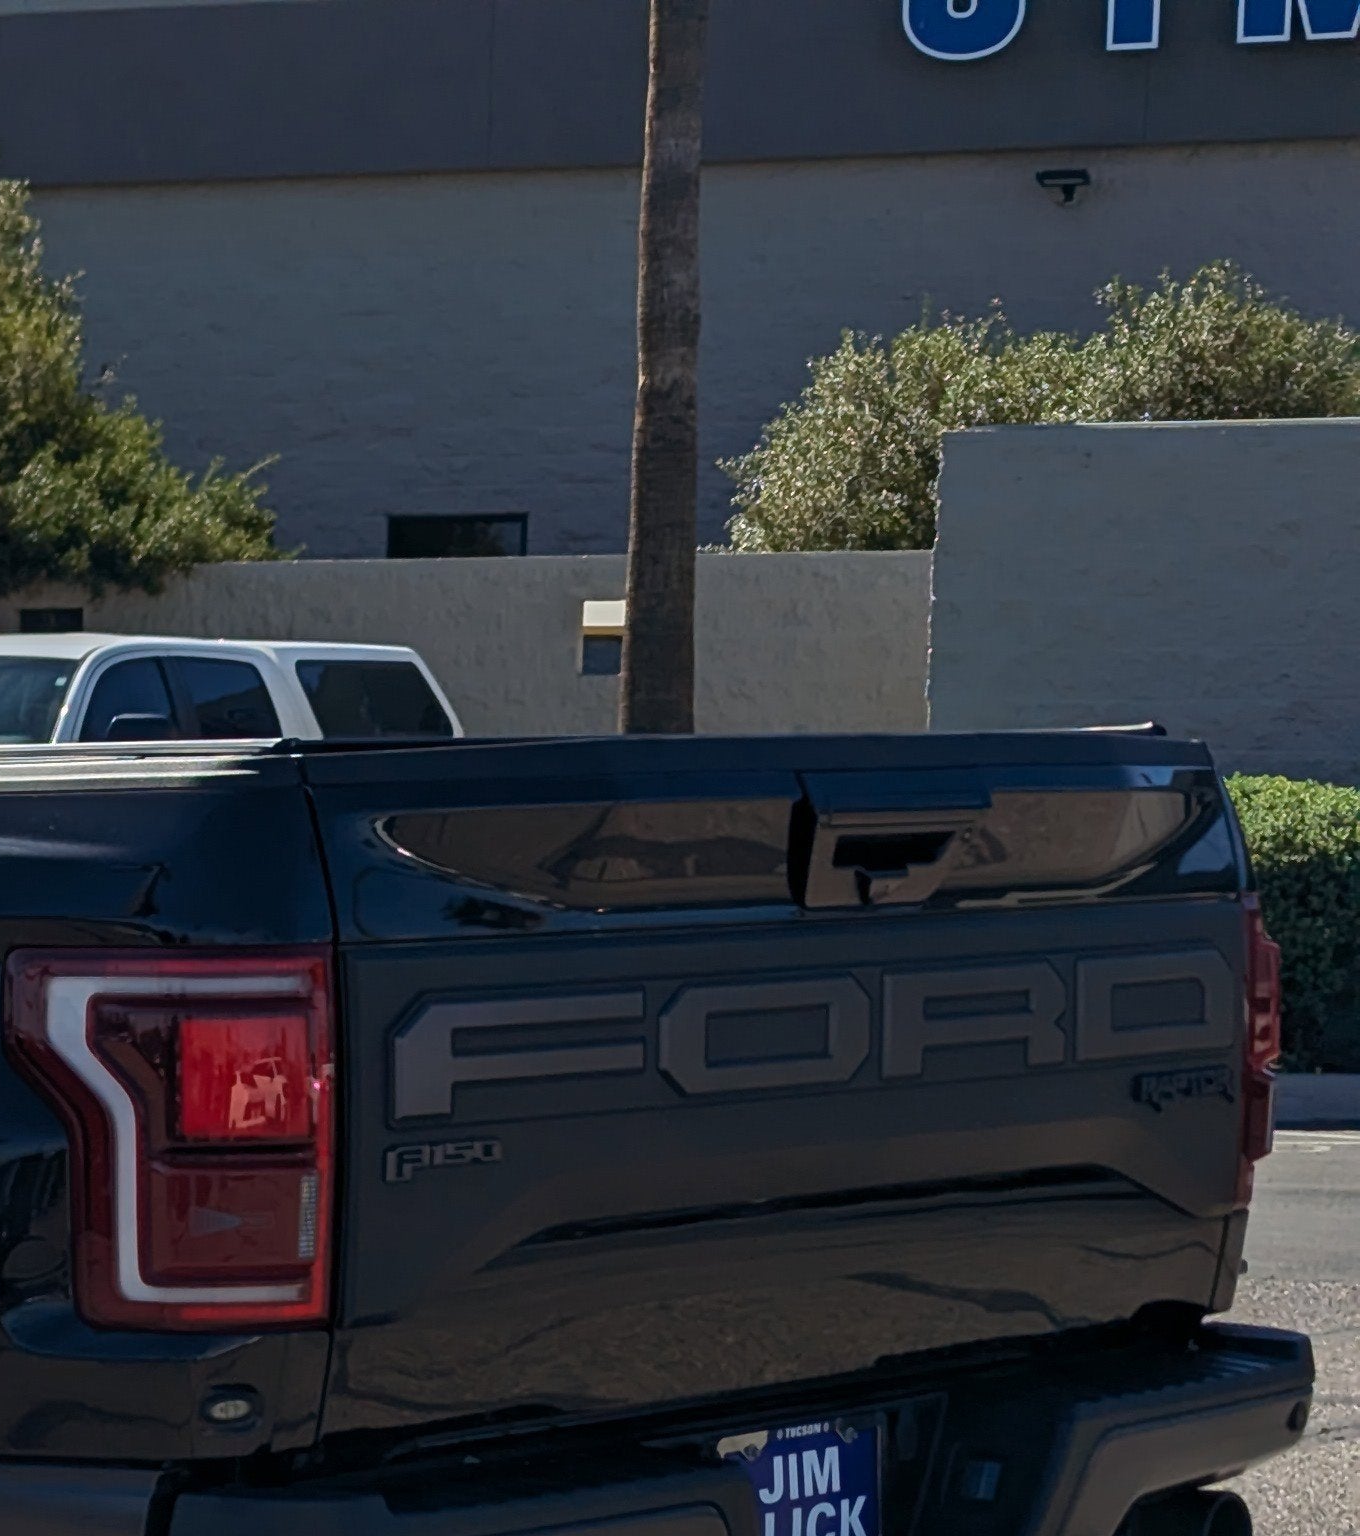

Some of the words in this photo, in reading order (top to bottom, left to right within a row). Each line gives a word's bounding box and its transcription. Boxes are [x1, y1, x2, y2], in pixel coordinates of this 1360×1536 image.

[392, 948, 1237, 1120] FORD
[785, 1422, 822, 1440] TUCSON
[758, 1445, 841, 1505] JIM
